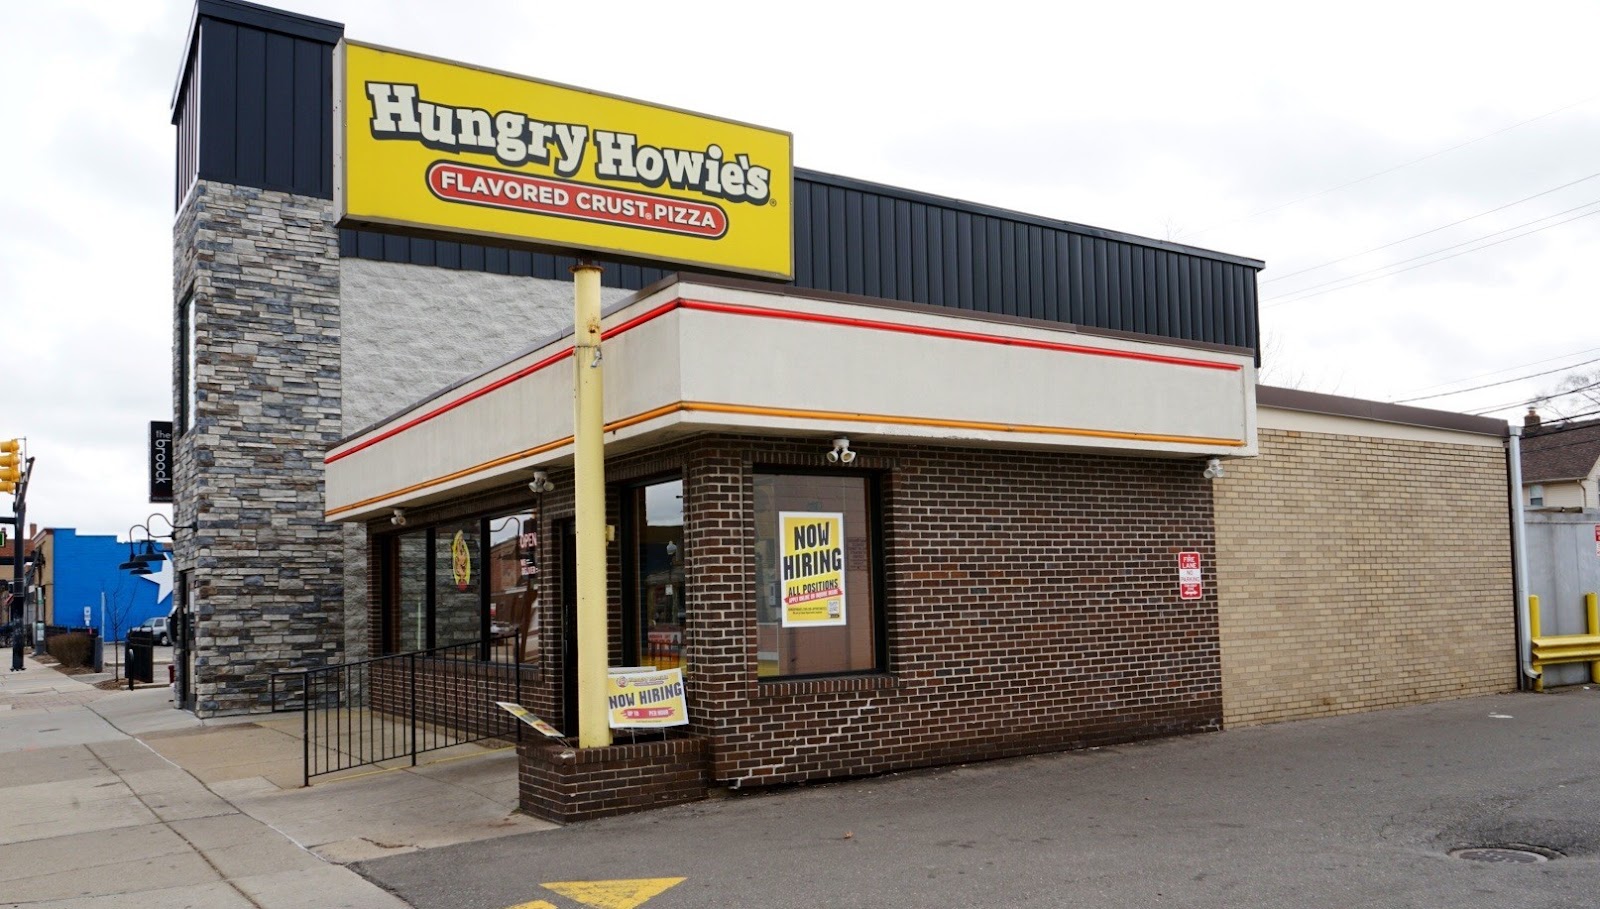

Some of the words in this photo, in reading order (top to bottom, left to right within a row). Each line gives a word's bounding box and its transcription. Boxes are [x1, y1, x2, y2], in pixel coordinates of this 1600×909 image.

[365, 81, 588, 177] Hungry
[595, 130, 771, 205] Howie's
[441, 171, 569, 206] FLAVORED
[576, 192, 647, 218] CRUST
[654, 205, 716, 229] PIZZA
[155, 430, 171, 439] the
[155, 439, 171, 484] brock
[520, 532, 537, 548] OPEN
[794, 522, 830, 550] NOW
[783, 547, 842, 580] HIRING
[789, 585, 800, 597] ALL
[803, 579, 838, 595] POSITIONS
[609, 692, 635, 709] NOW
[639, 682, 682, 705] HIRING
